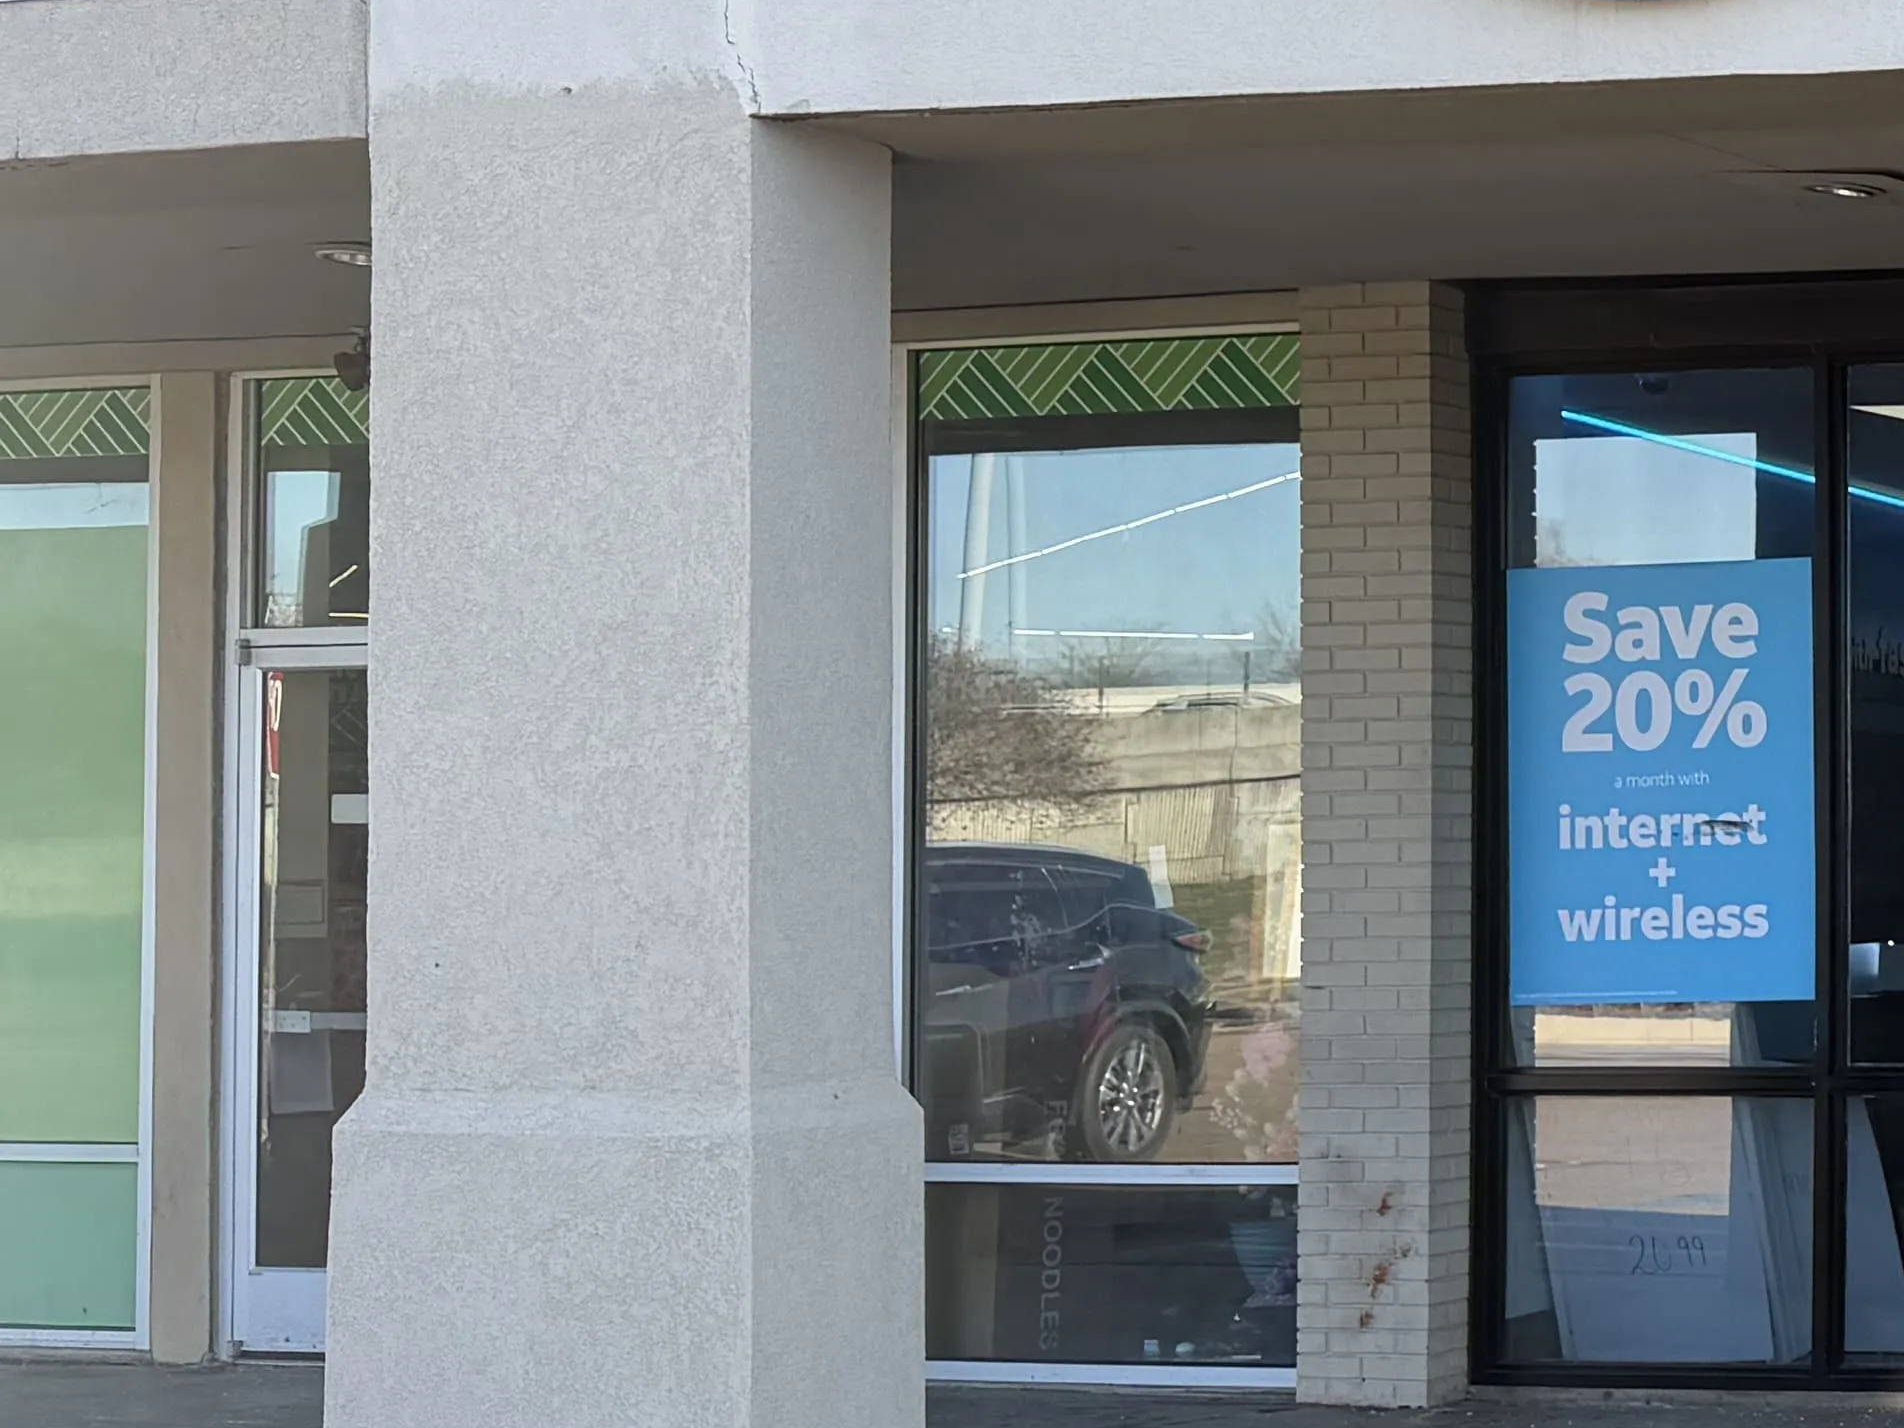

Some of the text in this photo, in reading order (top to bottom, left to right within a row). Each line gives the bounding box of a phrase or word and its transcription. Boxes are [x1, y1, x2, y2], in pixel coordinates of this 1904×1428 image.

[1562, 591, 1759, 664] Save
[1562, 668, 1768, 753] 20%
[1614, 769, 1710, 789] a month with
[1558, 803, 1768, 850] internet
[1648, 857, 1677, 888] +
[1557, 893, 1770, 943] wireless
[1037, 1194, 1065, 1352] NOODLES
